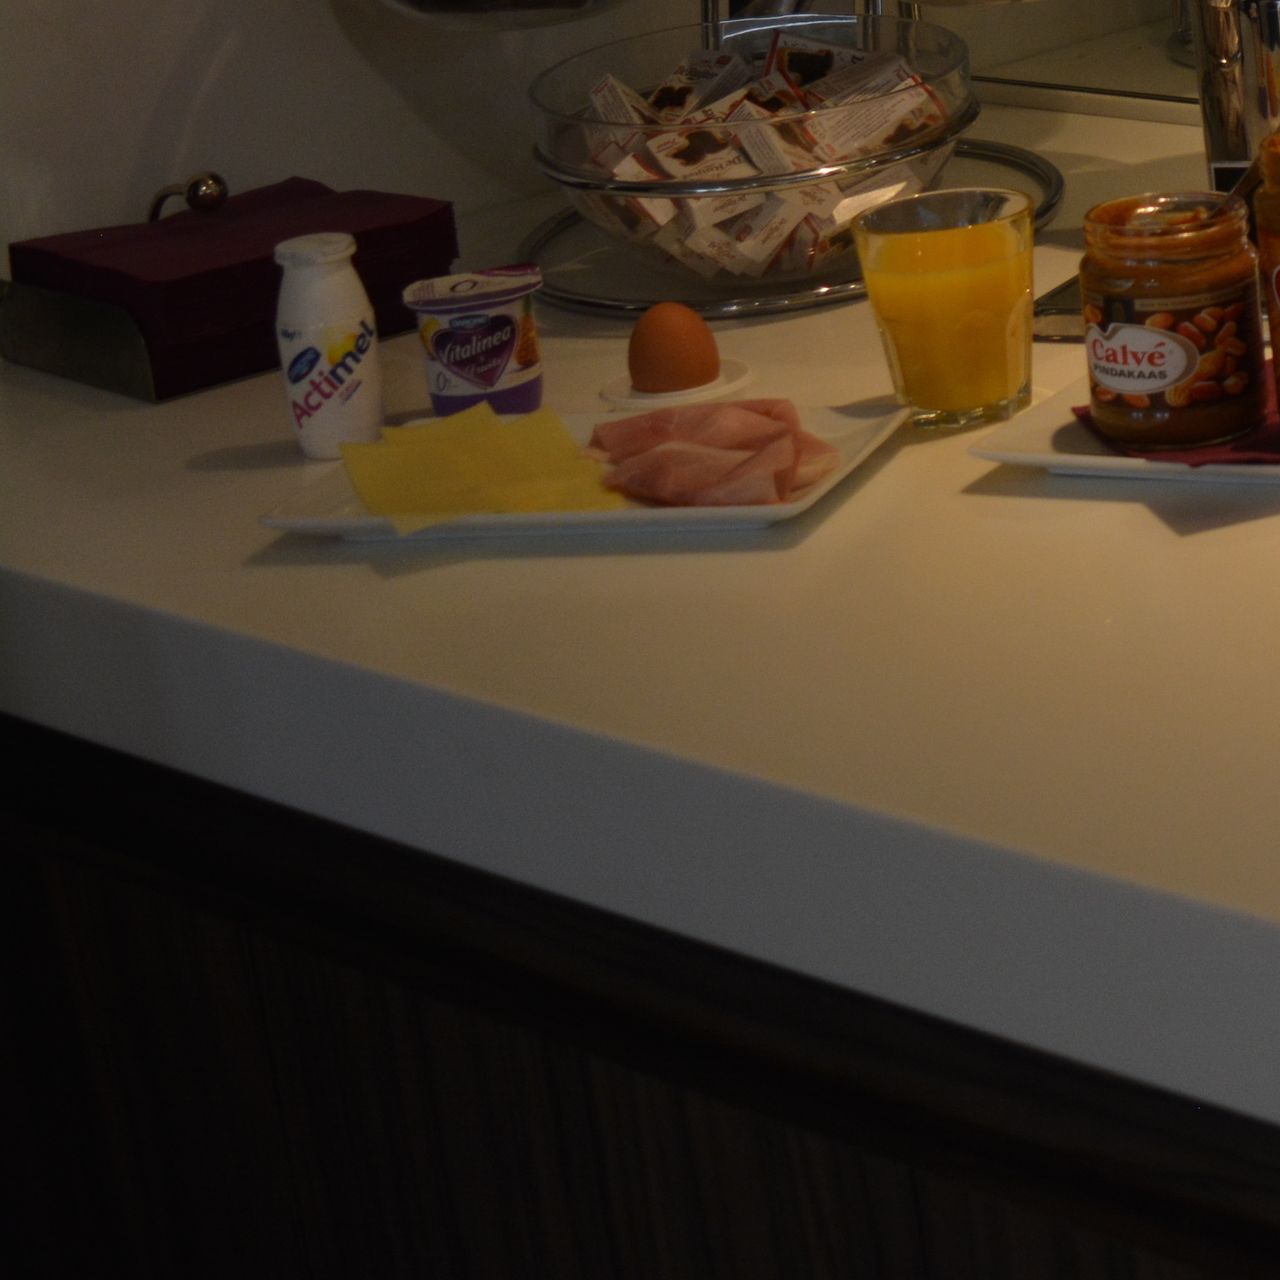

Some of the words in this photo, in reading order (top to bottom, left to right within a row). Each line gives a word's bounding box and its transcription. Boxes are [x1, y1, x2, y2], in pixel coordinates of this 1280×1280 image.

[441, 323, 512, 363] Vitalinea
[1092, 338, 1166, 368] Calvé
[291, 321, 374, 429] Actimel
